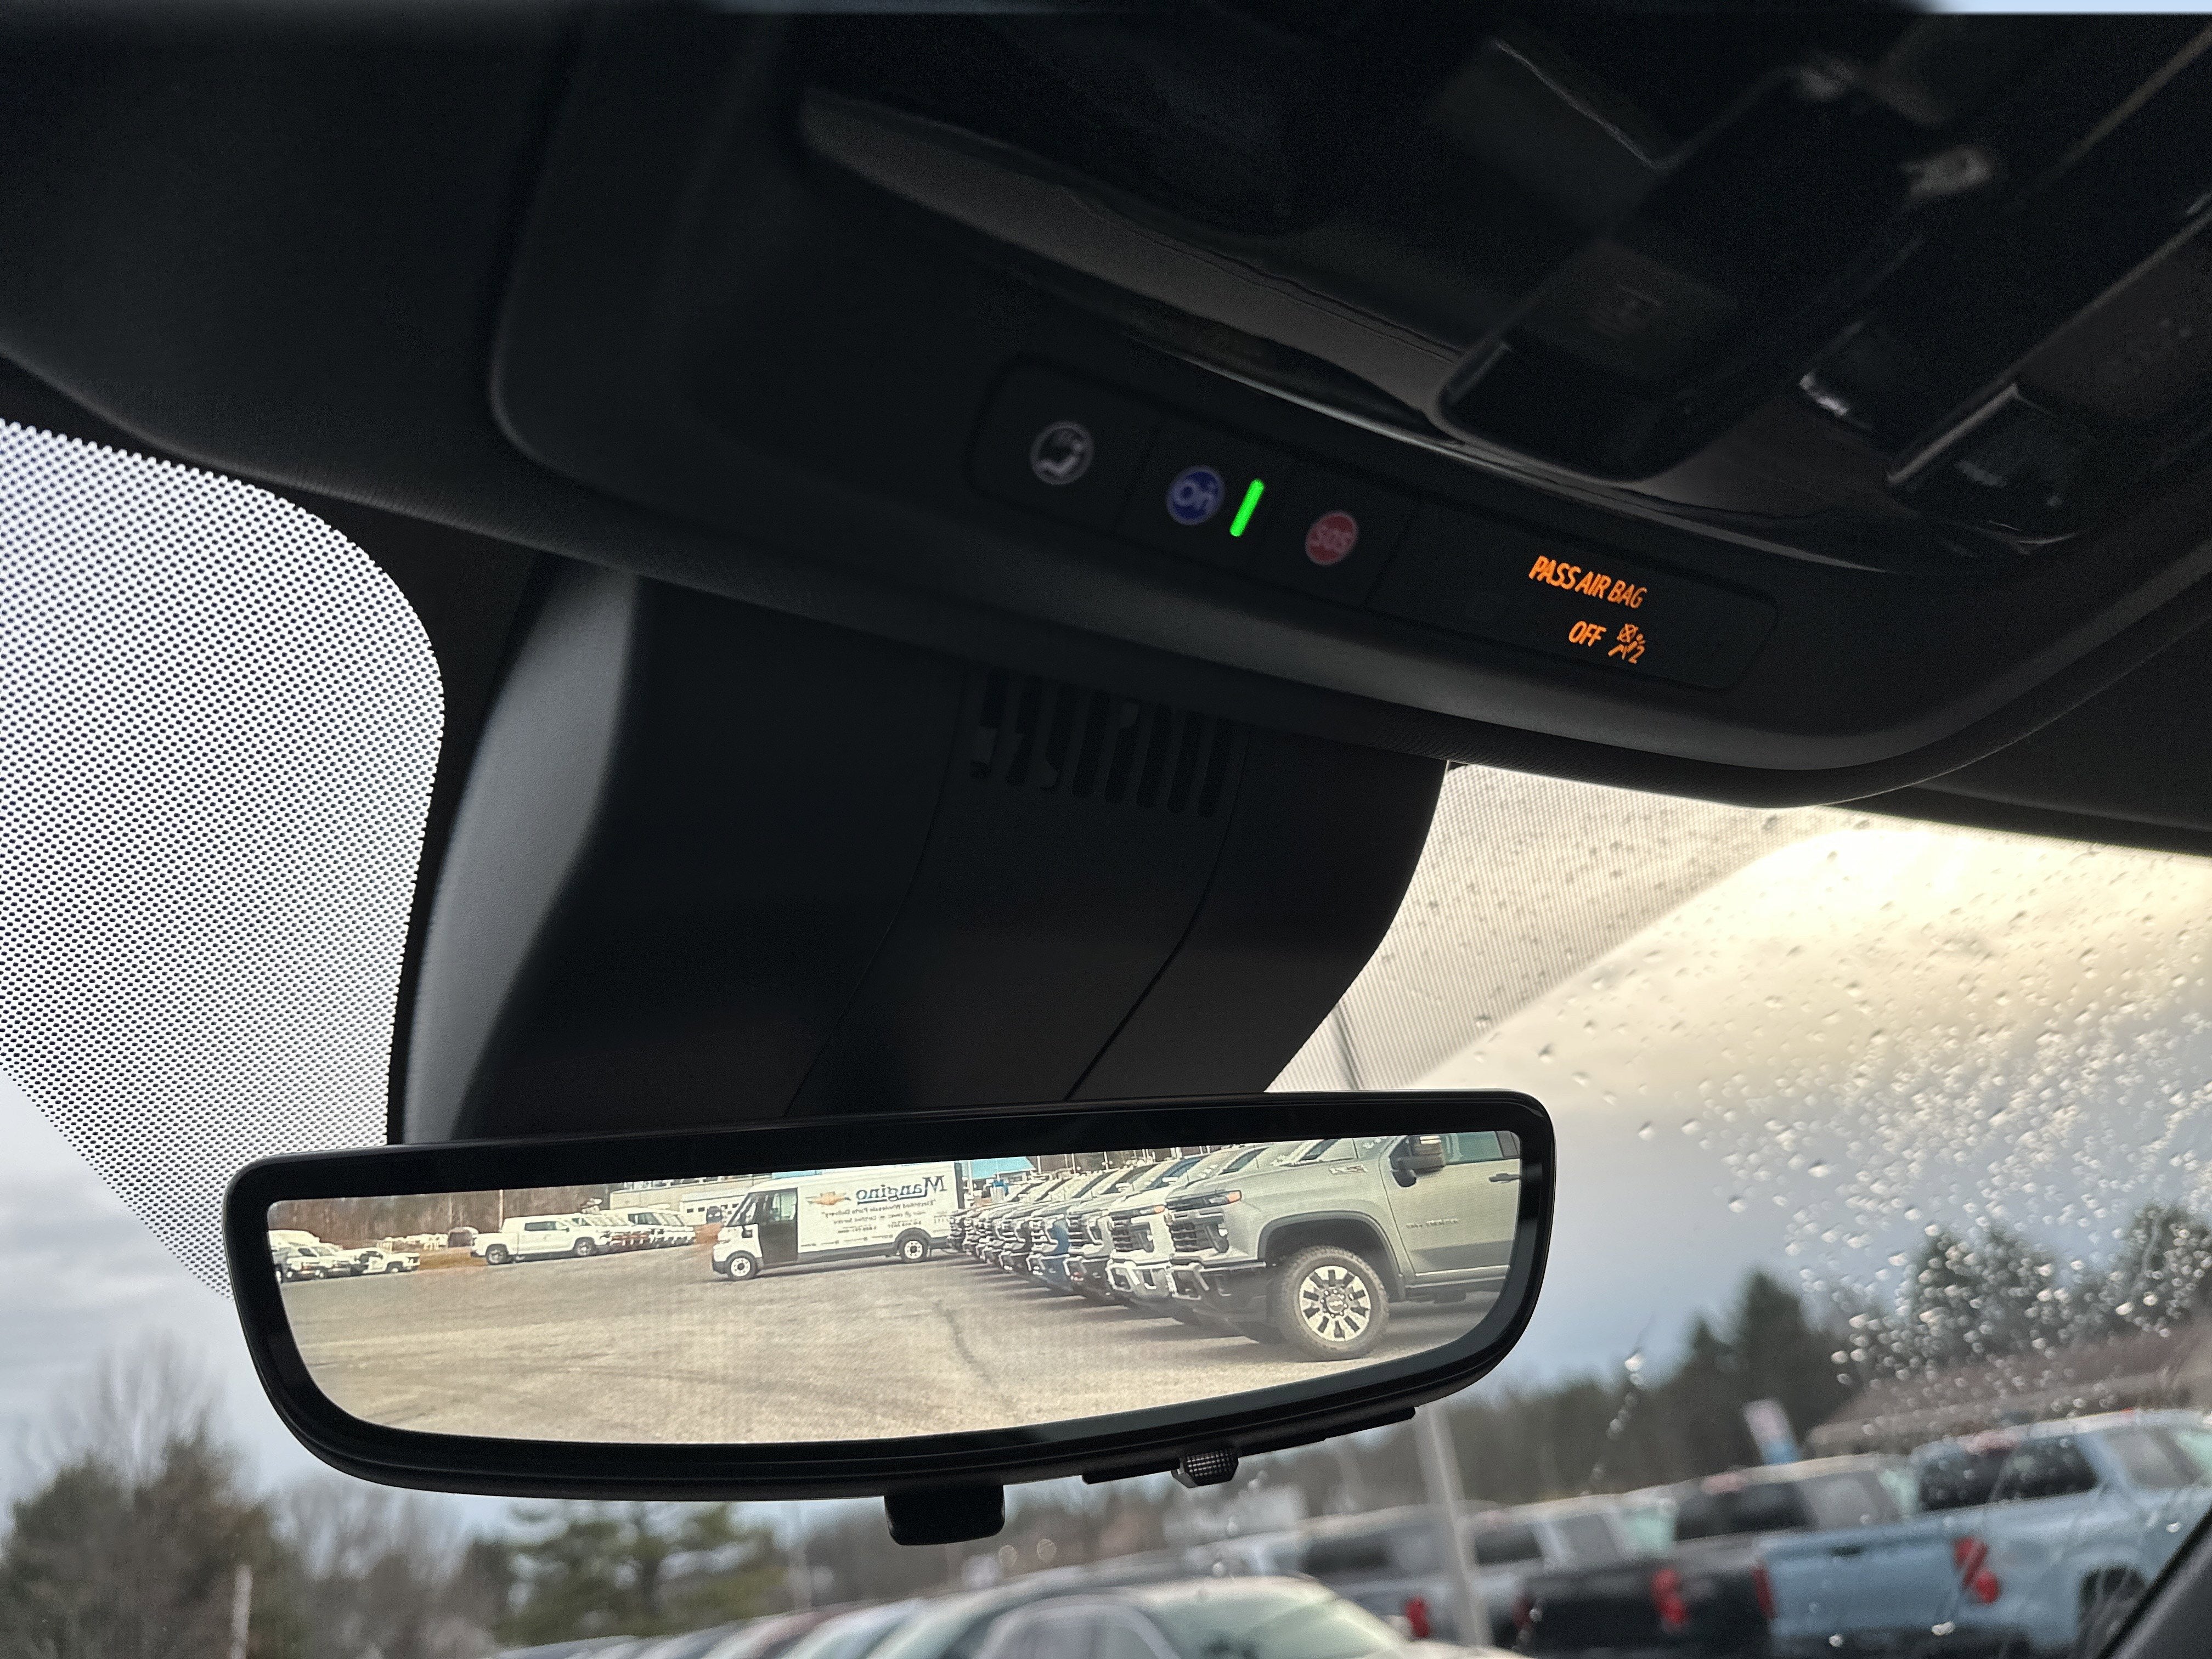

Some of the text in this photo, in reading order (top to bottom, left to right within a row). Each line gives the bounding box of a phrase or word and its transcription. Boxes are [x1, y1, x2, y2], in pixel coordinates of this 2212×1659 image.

[1310, 520, 1352, 554] SOS
[1528, 555, 1647, 609] PASS AIR BAG
[1568, 620, 1607, 647] OFF
